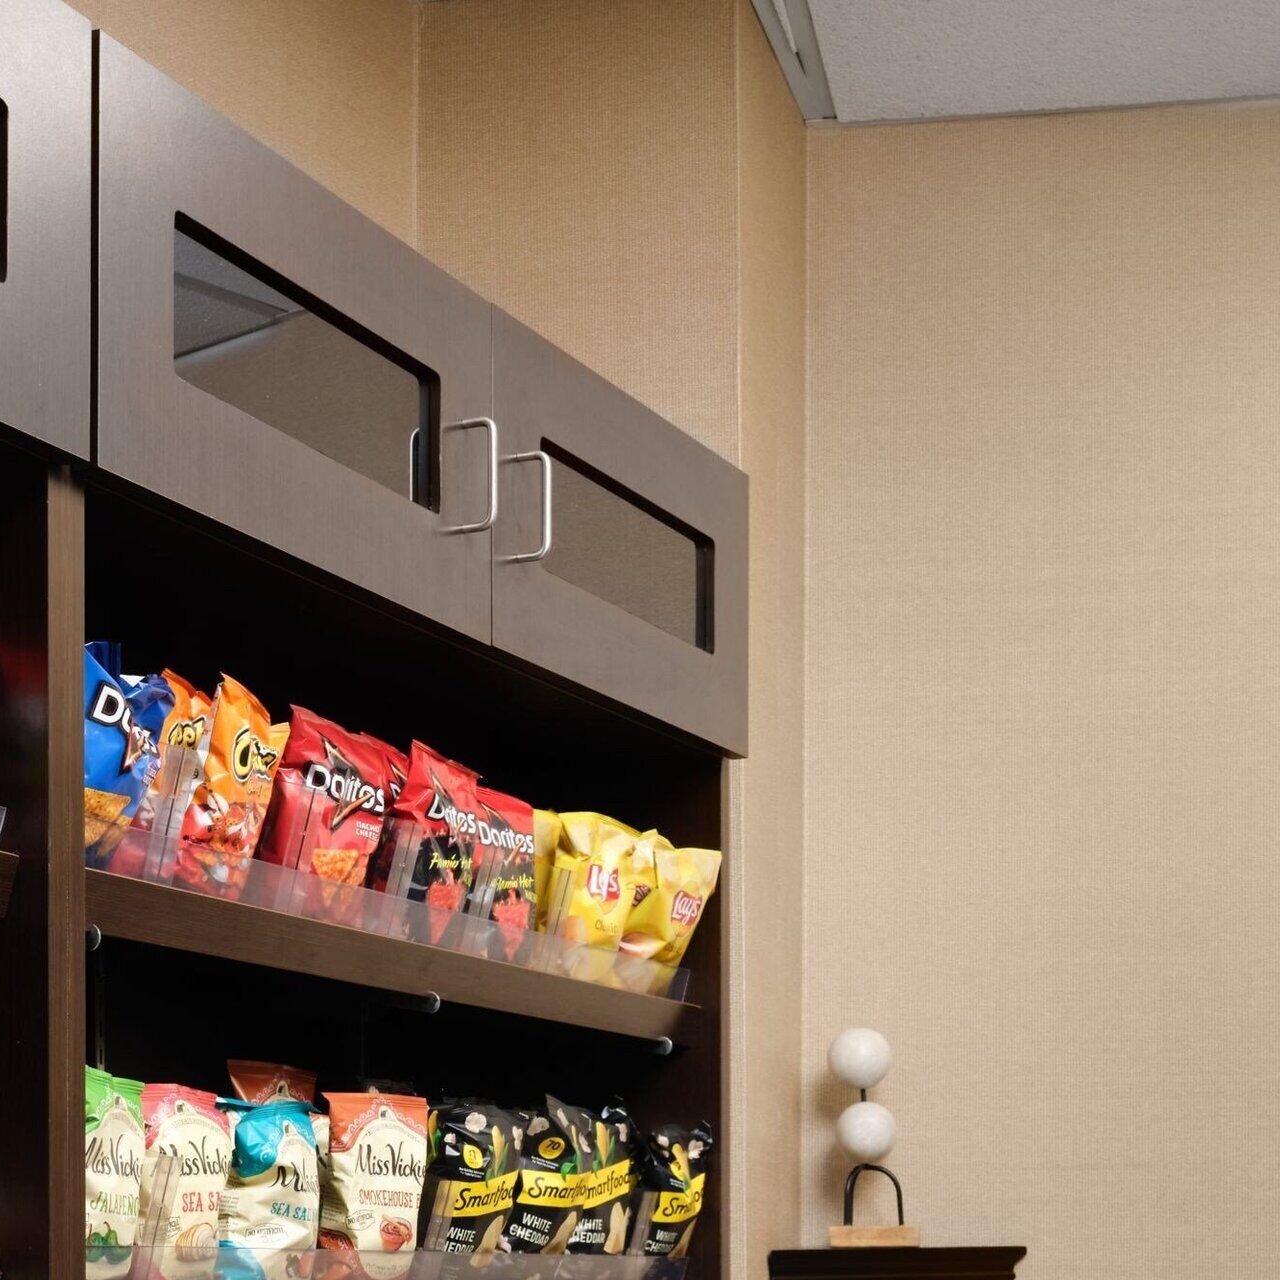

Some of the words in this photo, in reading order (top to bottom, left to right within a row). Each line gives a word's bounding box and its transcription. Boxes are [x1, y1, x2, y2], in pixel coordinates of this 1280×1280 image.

[306, 764, 384, 813] Doritos
[478, 820, 534, 853] Doritos
[545, 1140, 561, 1151] 70
[356, 1143, 391, 1177] Miss
[182, 1191, 204, 1213] SEA
[271, 1201, 290, 1217] SEA
[359, 1189, 413, 1208] SMOKEHOUSE
[522, 1212, 552, 1232] WHITE
[447, 1227, 476, 1242] WHITE
[510, 1223, 549, 1246] CHEDDAR
